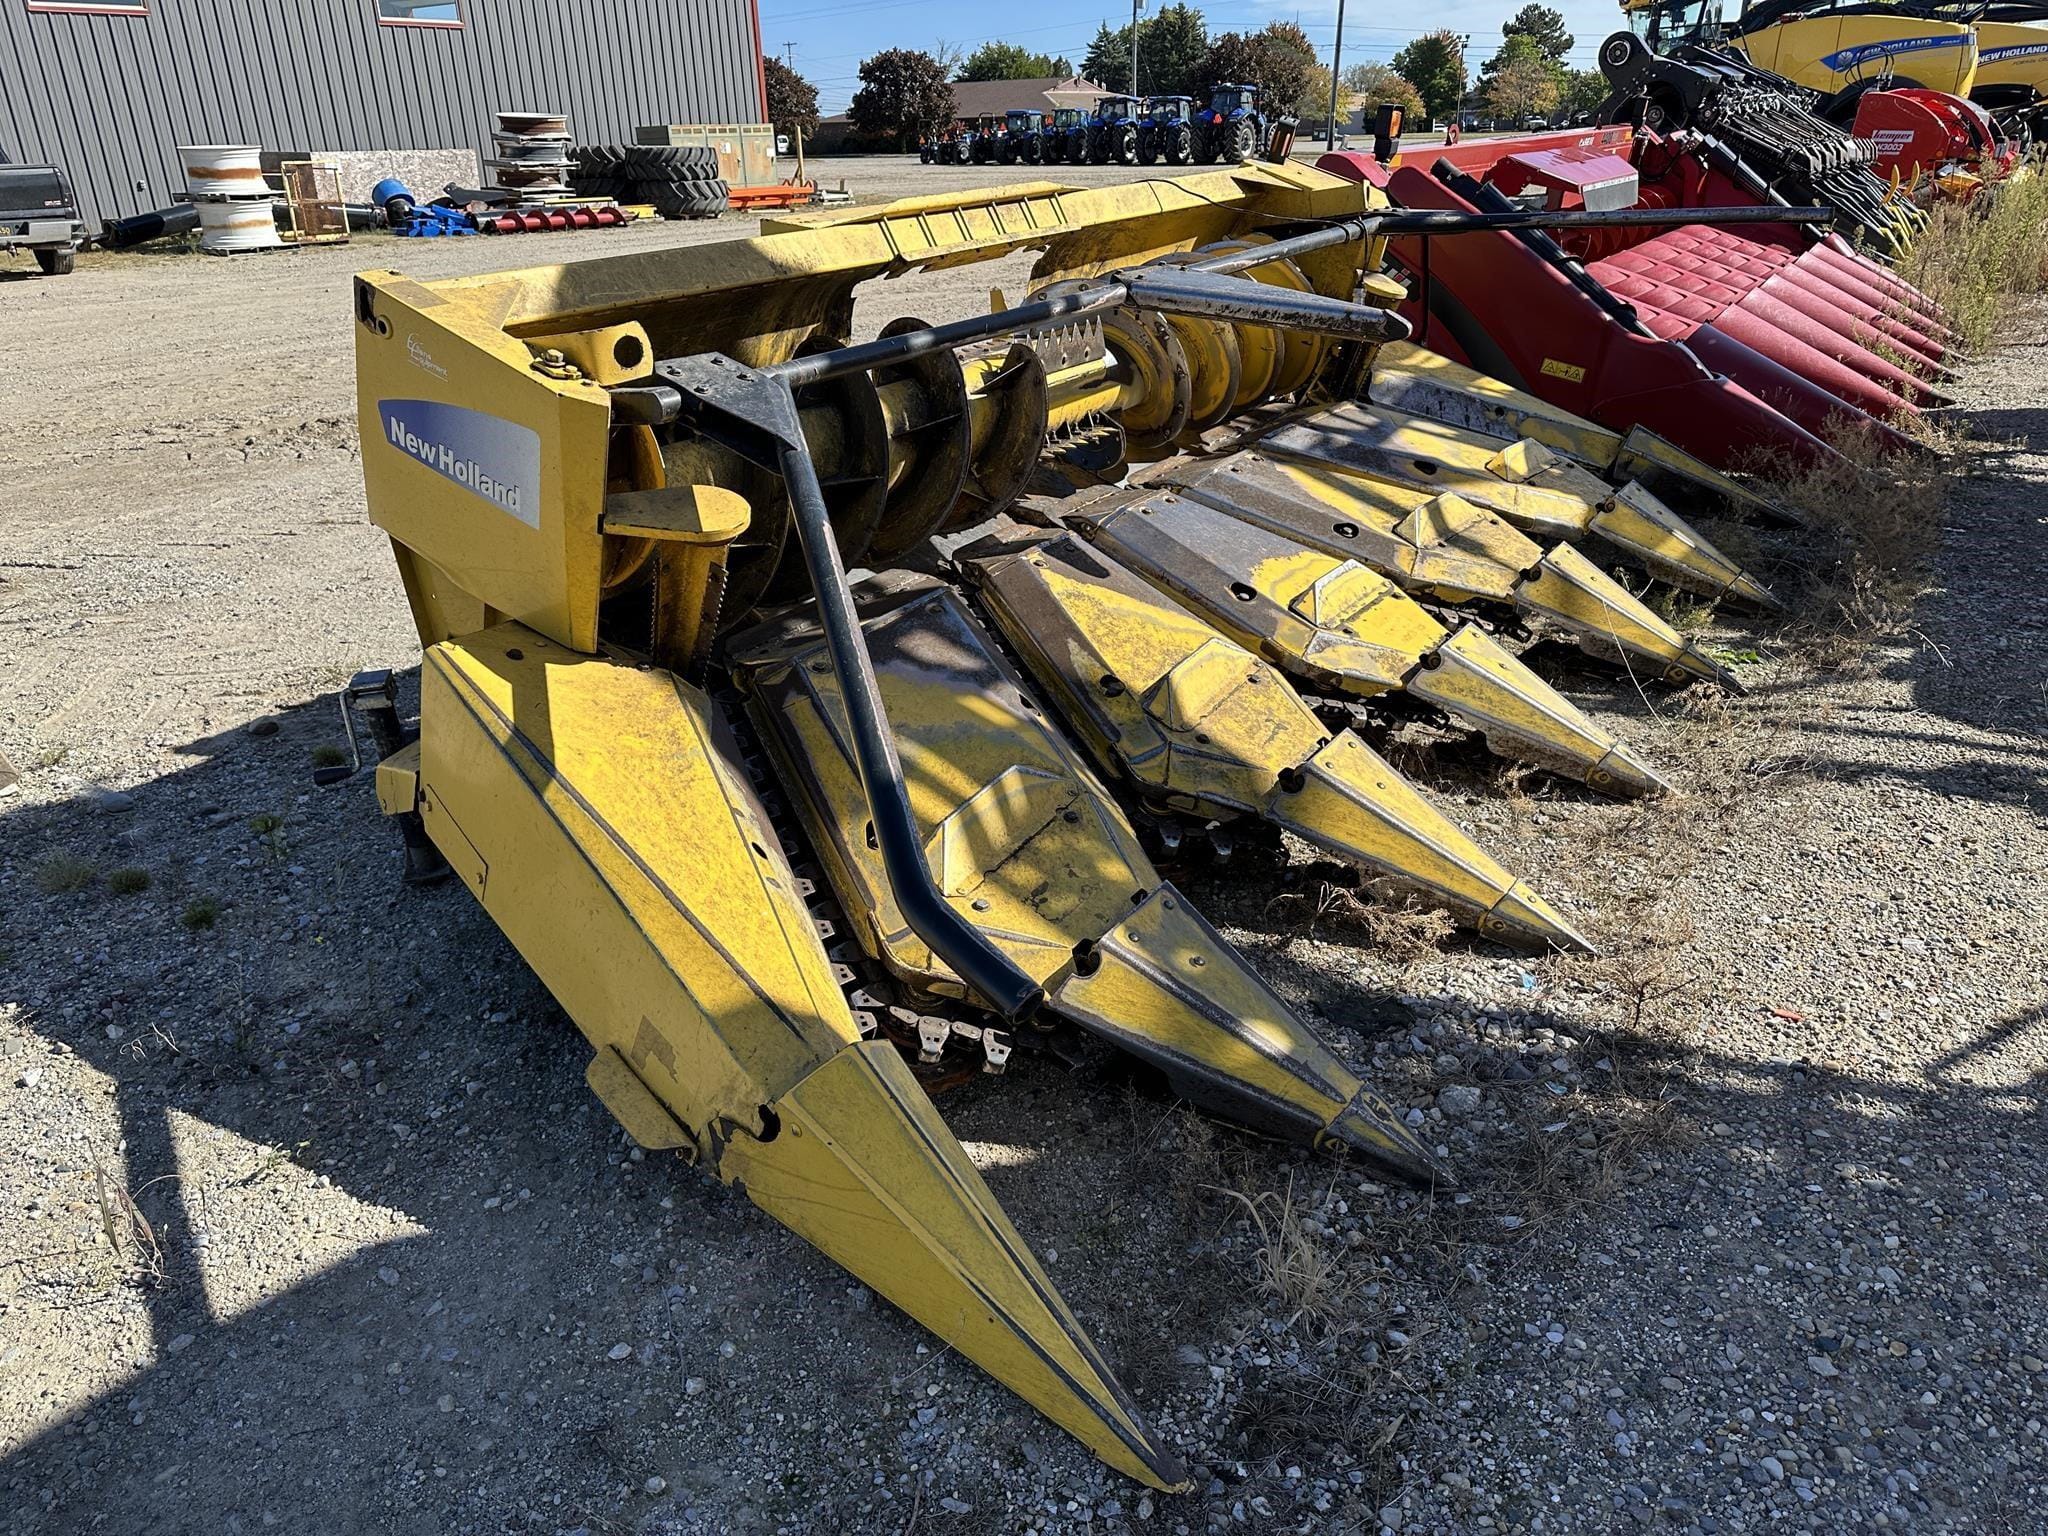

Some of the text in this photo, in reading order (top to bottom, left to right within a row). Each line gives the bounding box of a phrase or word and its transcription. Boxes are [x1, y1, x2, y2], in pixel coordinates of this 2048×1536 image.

[1884, 39, 1932, 51] HOLLAND
[1978, 45, 2047, 63] NEW HOLLAND
[1873, 130, 1912, 142] kemper
[390, 416, 521, 513] New Holland
